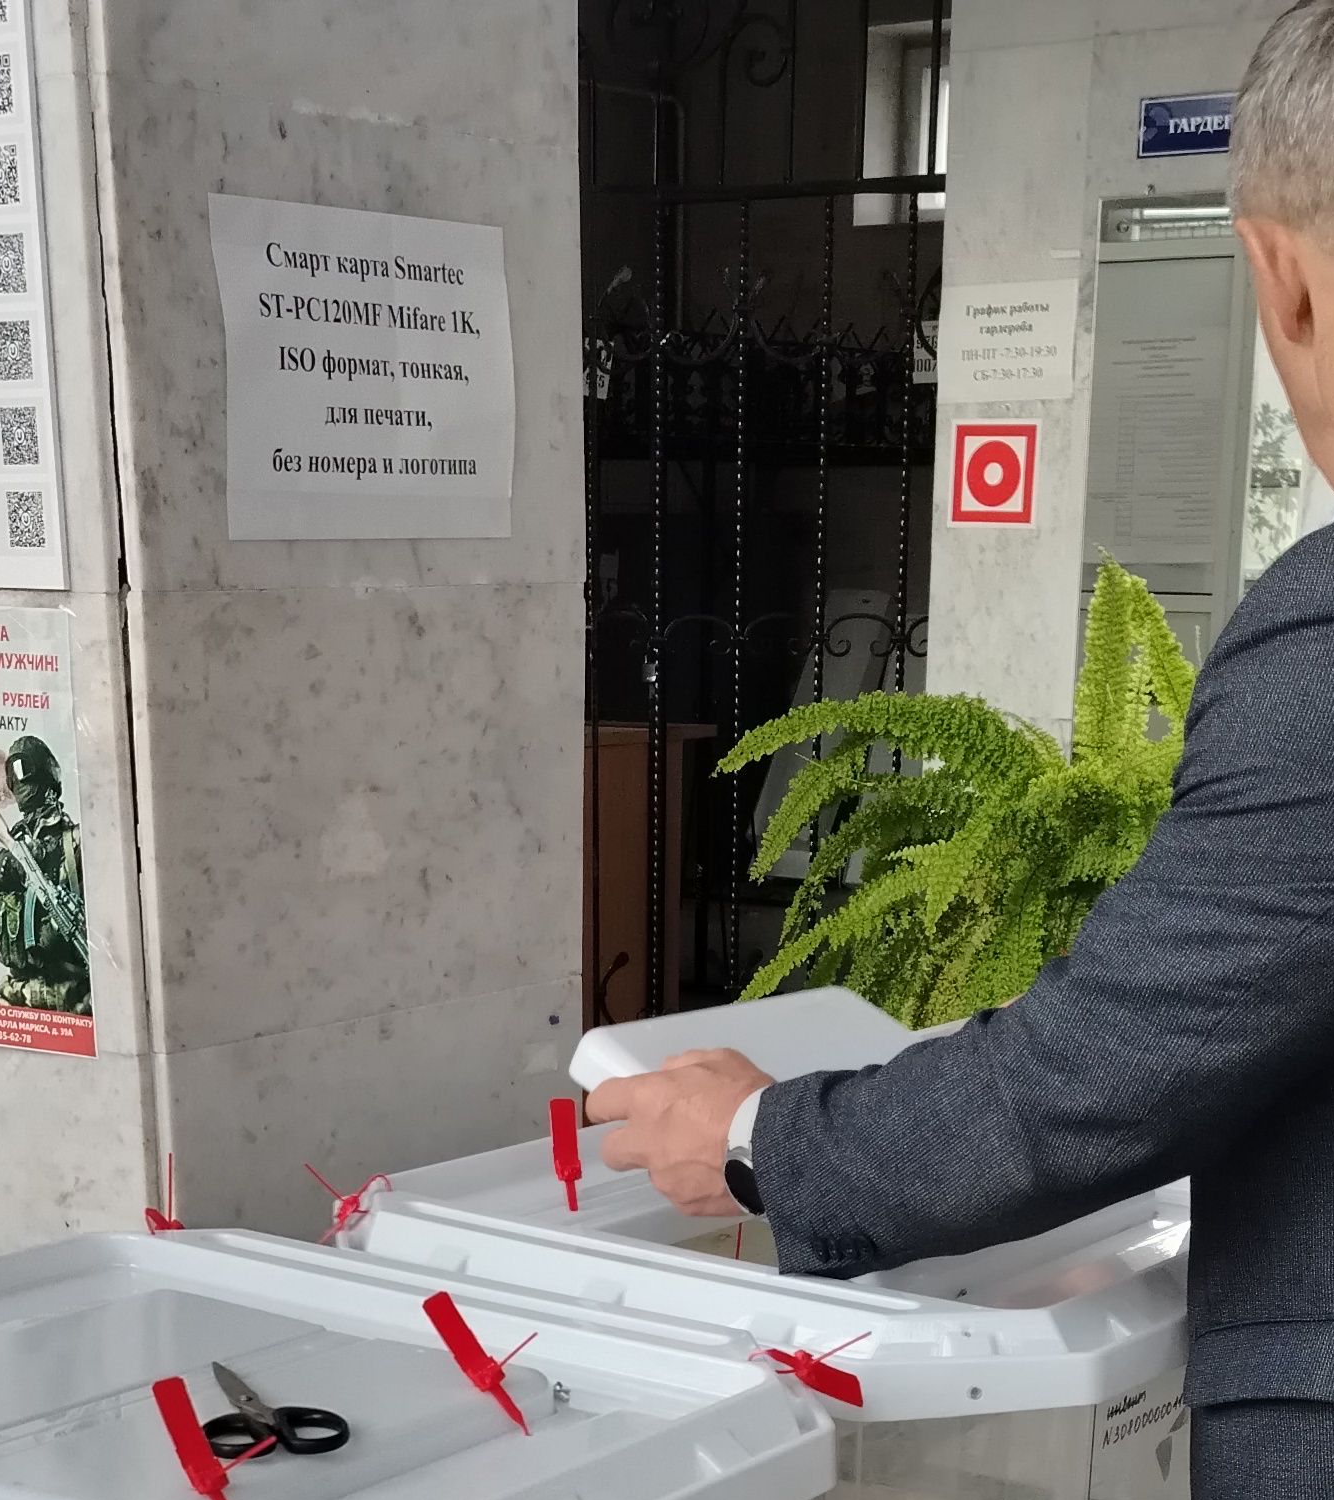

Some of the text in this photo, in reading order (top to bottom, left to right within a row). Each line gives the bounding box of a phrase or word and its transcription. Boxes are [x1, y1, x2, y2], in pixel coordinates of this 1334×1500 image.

[266, 242, 465, 286] Смарт карта Smartec
[258, 292, 382, 328] ST-PC120MF
[387, 305, 446, 332] Mifare
[965, 301, 1050, 320] График работы
[979, 321, 1034, 337] гардероба
[279, 346, 470, 386] ISO формат, тонкая,
[325, 406, 433, 431] для печати,
[272, 448, 477, 480] без номера и логотипа
[2, 691, 50, 709] РУБЛЕЙ
[8, 1008, 39, 1021] СЛУЖБУ
[40, 1011, 51, 1022] ПО
[52, 1014, 93, 1028] КОНТРАКТУ
[19, 1022, 51, 1035] МАРКСА,
